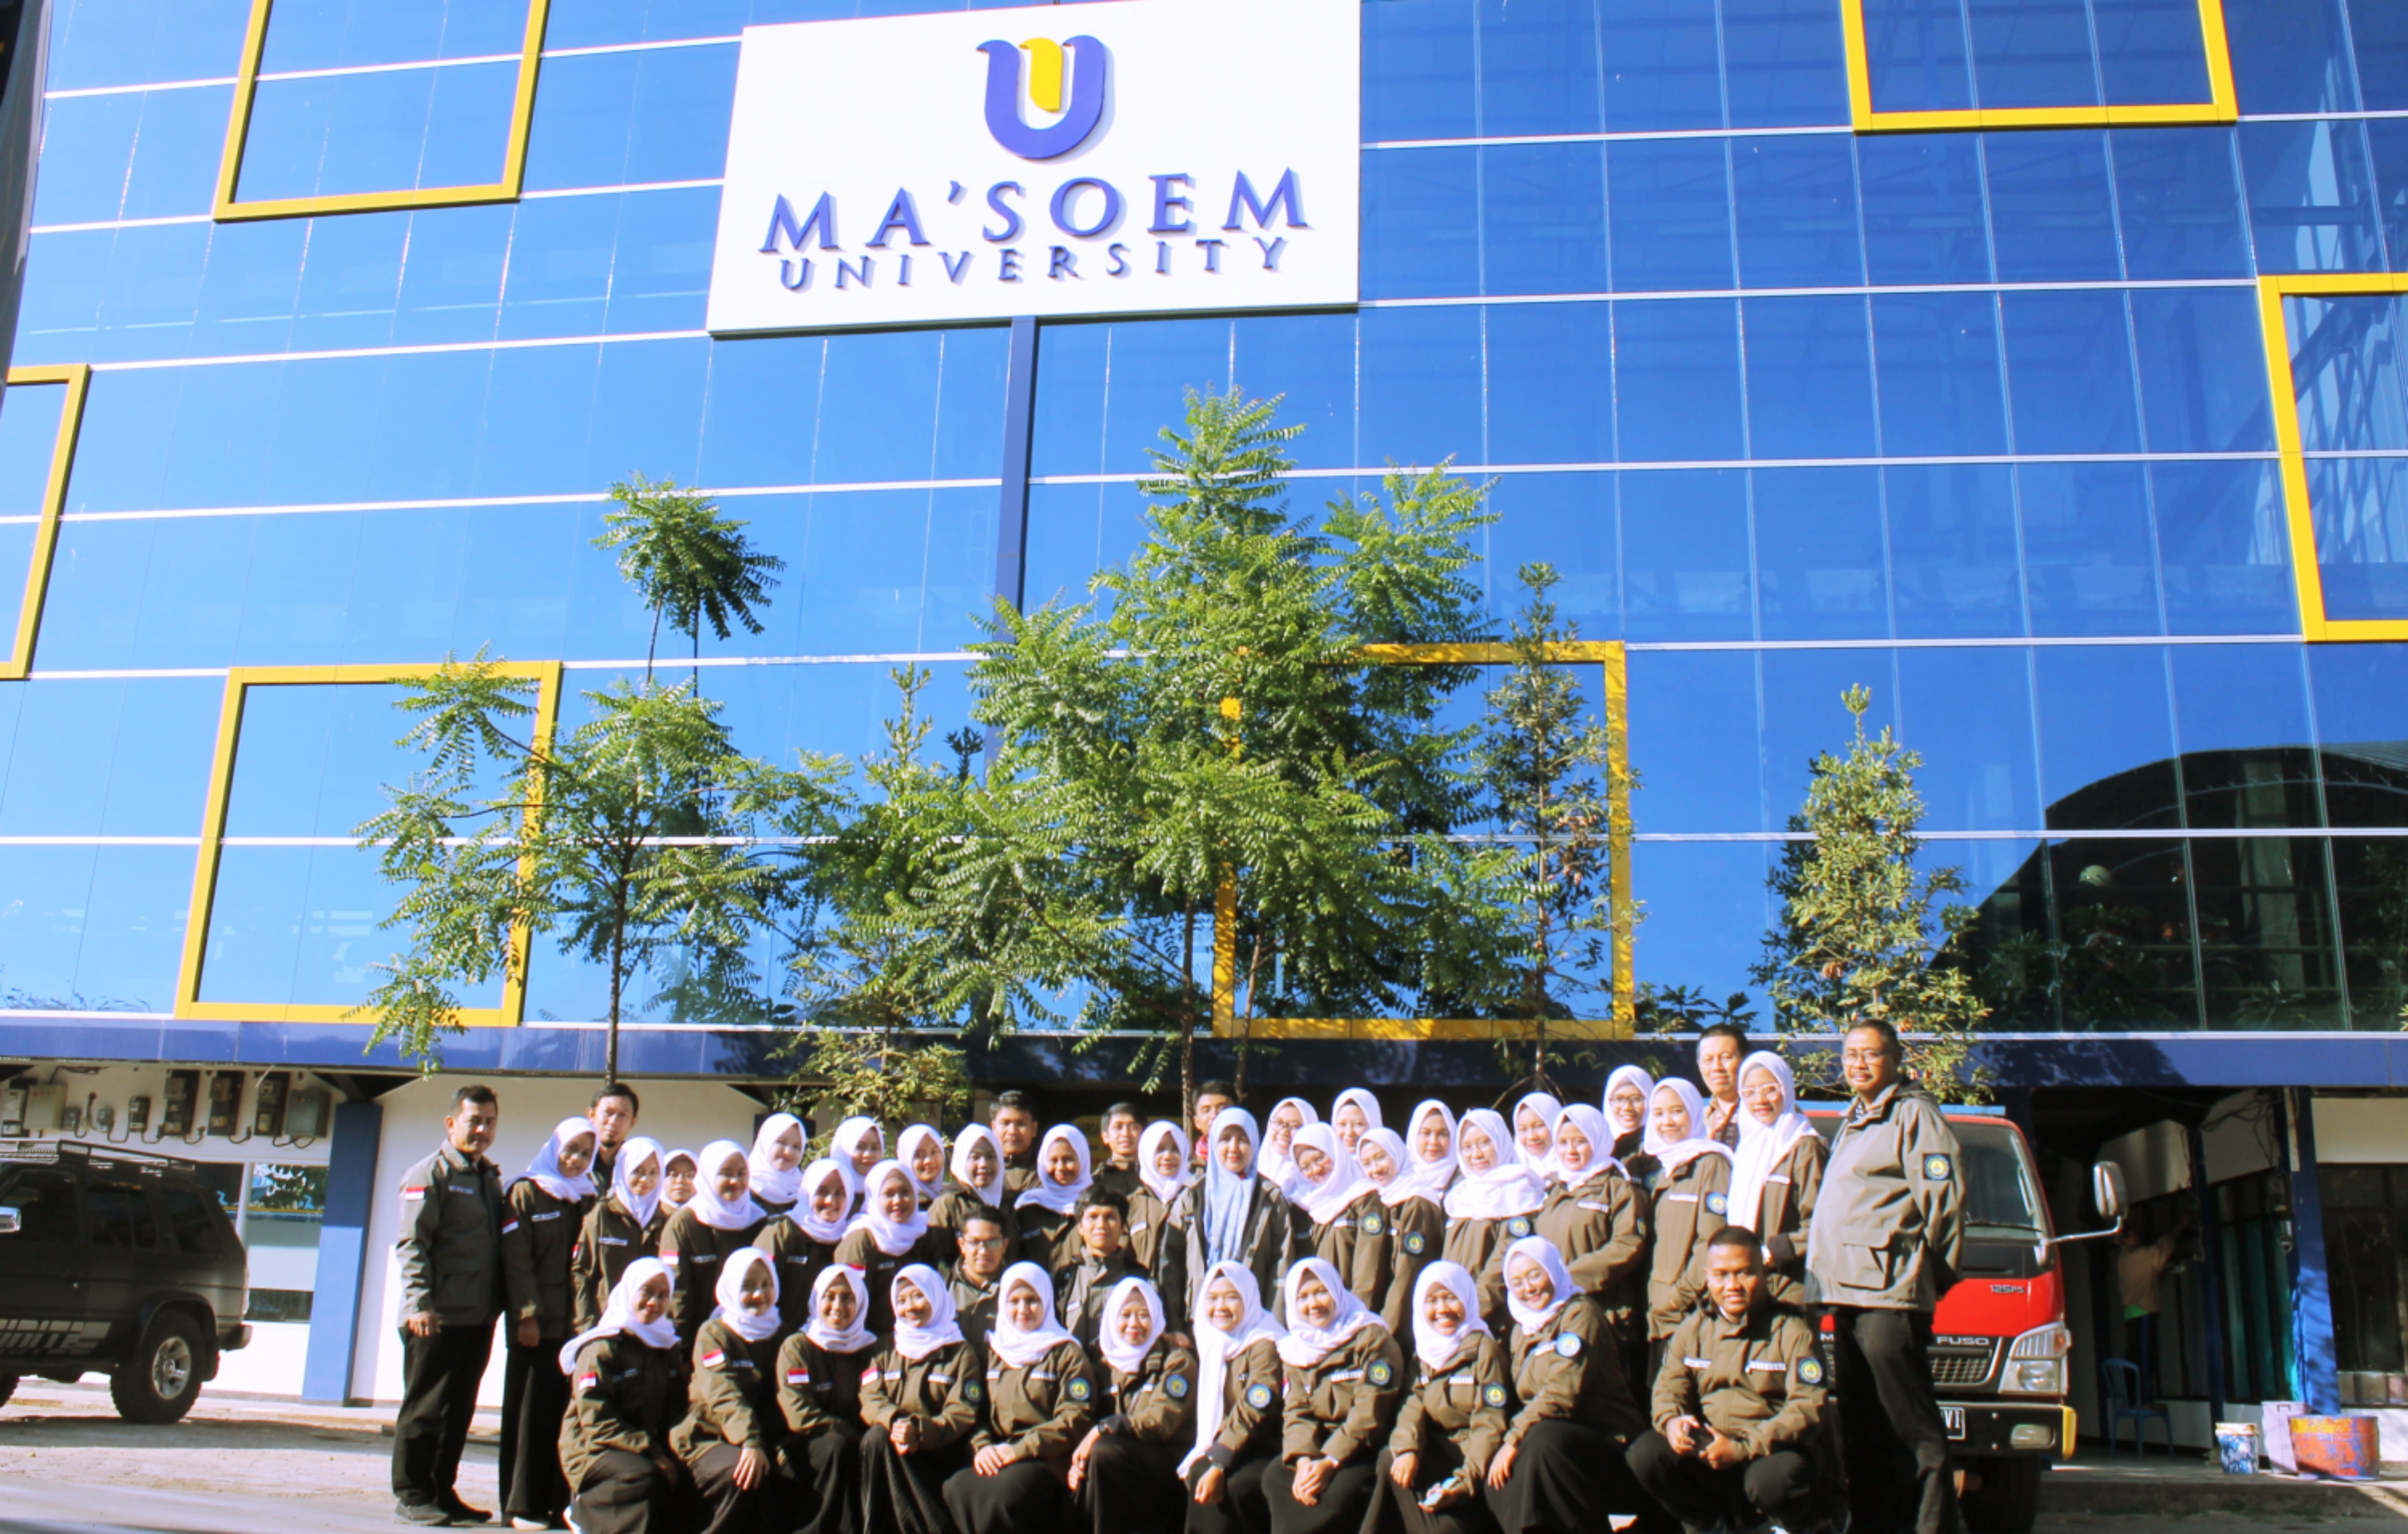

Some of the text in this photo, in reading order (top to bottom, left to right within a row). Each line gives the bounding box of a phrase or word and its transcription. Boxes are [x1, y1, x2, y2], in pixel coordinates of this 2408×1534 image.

[759, 167, 1310, 254] MA'SOEM
[780, 237, 1282, 291] UNIVERSITY
[1936, 1336, 1990, 1345] FUSO
